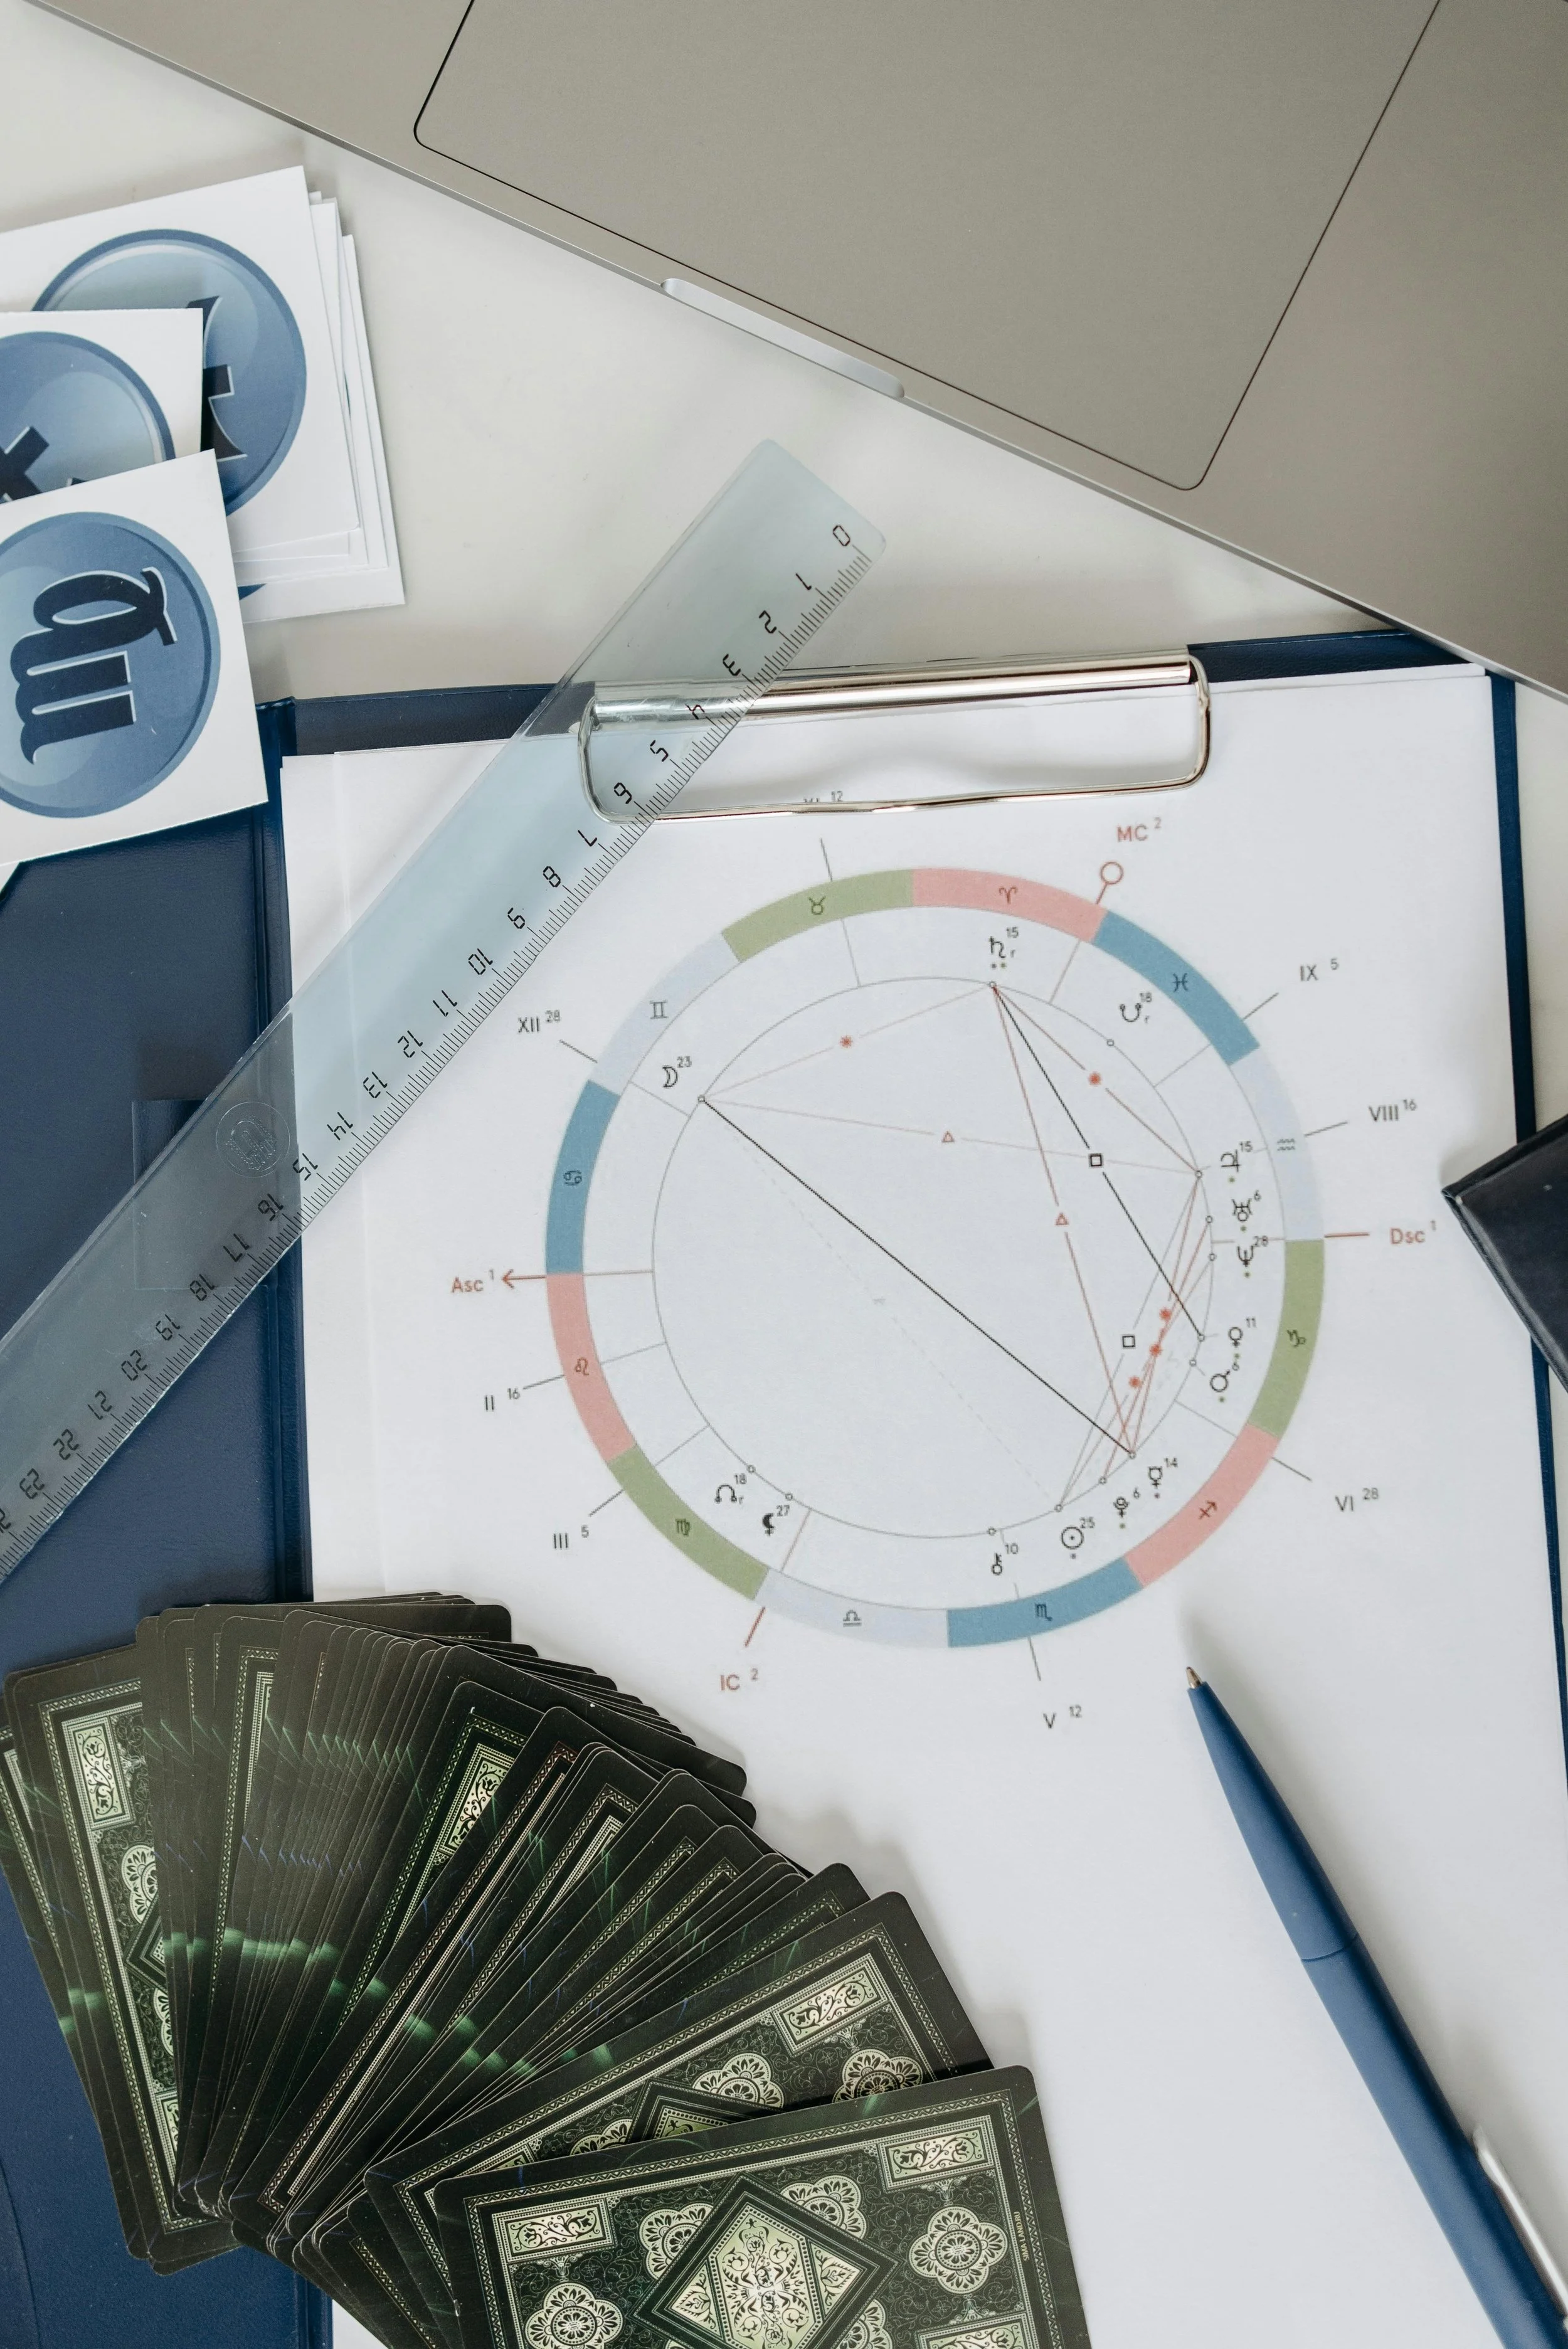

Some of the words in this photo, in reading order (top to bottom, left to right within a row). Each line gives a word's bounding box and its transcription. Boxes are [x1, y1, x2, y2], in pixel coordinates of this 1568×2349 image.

[832, 525, 850, 546] 0
[796, 573, 812, 590] 1
[759, 610, 777, 634] 2
[723, 654, 741, 676] 3
[685, 703, 705, 719] 4
[650, 740, 669, 761] 5
[613, 782, 632, 804] 6
[578, 830, 597, 847] 7
[1116, 824, 1148, 842] MC
[1153, 817, 1162, 829] 2
[543, 866, 561, 887] 8
[507, 908, 525, 929] 9
[1006, 926, 1019, 938] 15
[469, 948, 493, 975] 10
[1300, 964, 1319, 982] IX
[1330, 957, 1340, 970] 5
[433, 990, 457, 1017] 11
[517, 1016, 540, 1034] XII
[398, 1031, 423, 1058] 12
[363, 1071, 388, 1098] 13
[1368, 1104, 1399, 1121] VIII
[1403, 1098, 1417, 1111] 16
[327, 1112, 353, 1140] 14
[1239, 1140, 1253, 1152] 15
[292, 1153, 318, 1180] 15
[258, 1194, 283, 1221] 16
[1254, 1189, 1261, 1202] 6
[1390, 1228, 1426, 1245] Dsc
[1431, 1220, 1436, 1231] 1
[223, 1233, 250, 1262] 17
[189, 1274, 215, 1301] 18
[451, 1276, 484, 1293] Asc
[489, 1268, 494, 1281] 1
[156, 1314, 181, 1340] 19
[1246, 1317, 1256, 1328] 11
[121, 1350, 147, 1381] 20
[1232, 1361, 1239, 1371] 6
[87, 1390, 112, 1420] 21
[484, 1394, 494, 1412] II
[507, 1387, 521, 1400] 16
[53, 1428, 79, 1460] 22
[1164, 1457, 1178, 1468] 14
[19, 1468, 45, 1499] 23
[734, 1473, 747, 1485] 18
[1133, 1487, 1140, 1499] 6
[1335, 1495, 1354, 1512] VI
[1362, 1487, 1379, 1500] 28
[0, 1507, 11, 1533] 2
[776, 1505, 790, 1517] 27
[553, 1532, 568, 1549] III
[581, 1525, 590, 1538] 5
[1005, 1542, 1019, 1554] 10
[720, 1673, 740, 1691] IC
[751, 1668, 758, 1680] 2
[1042, 1712, 1057, 1729] V
[1069, 1704, 1083, 1719] 12
[1014, 2211, 1029, 2261] SIMA-LAND.RU
